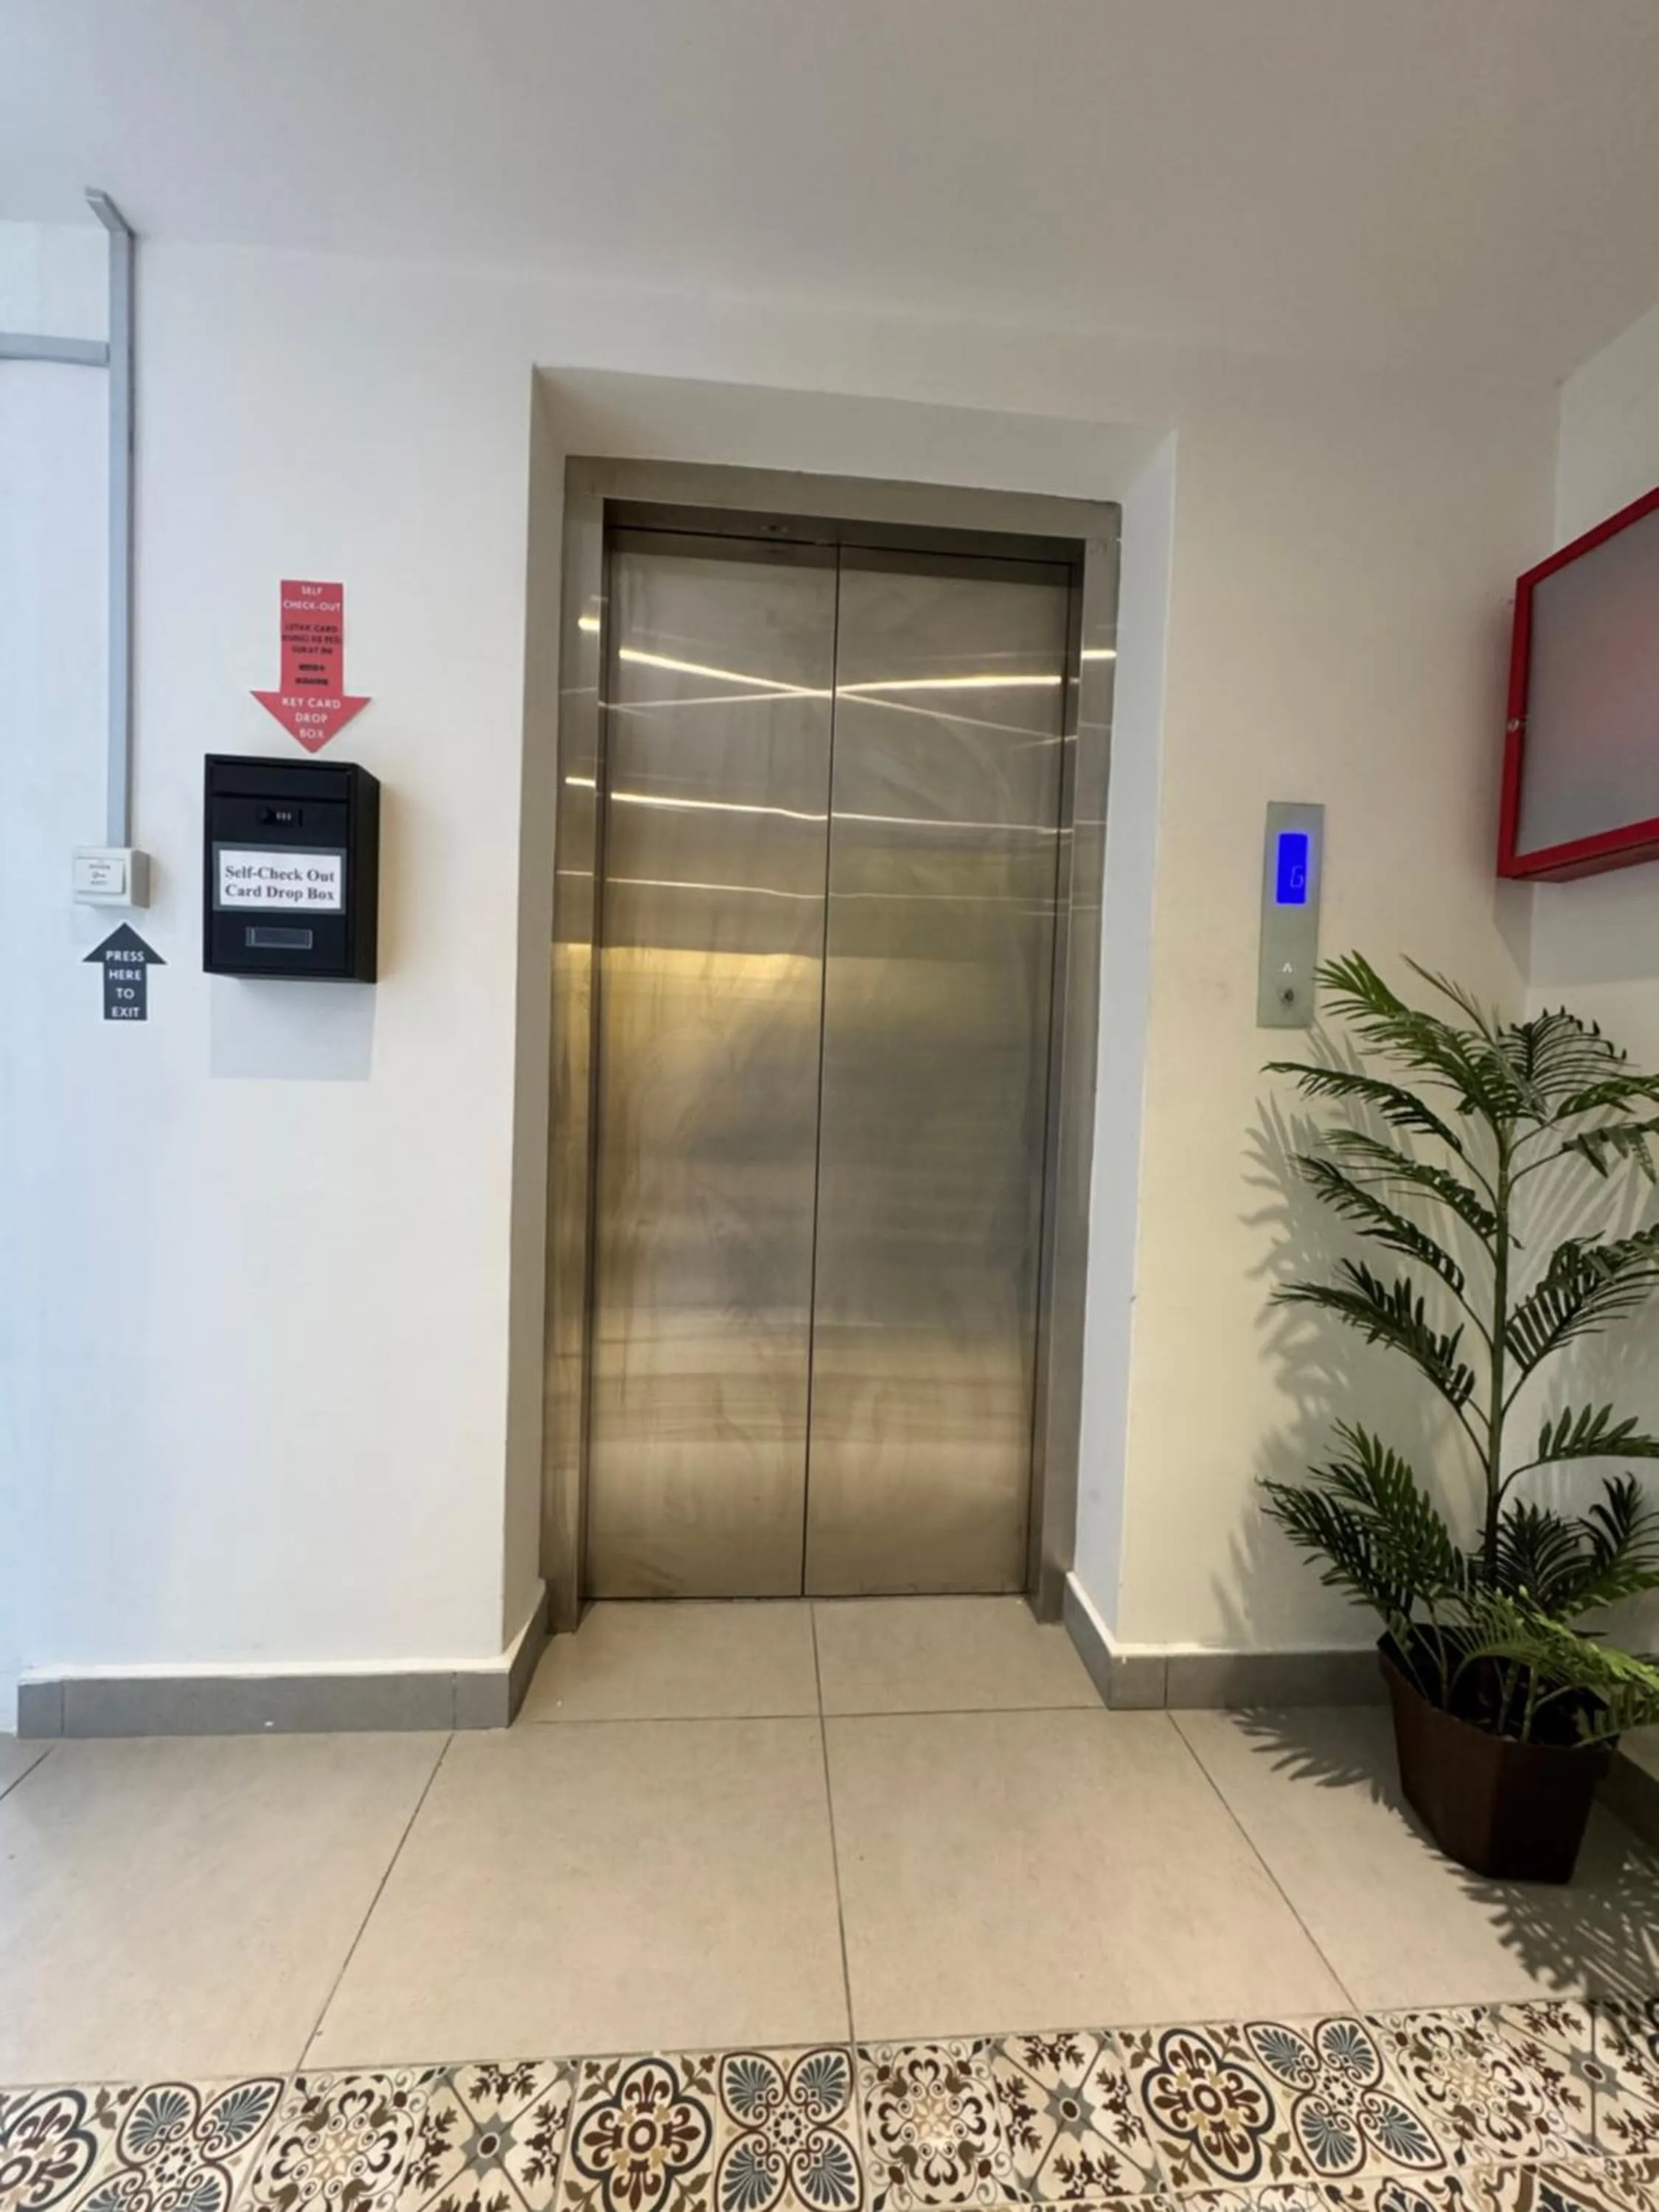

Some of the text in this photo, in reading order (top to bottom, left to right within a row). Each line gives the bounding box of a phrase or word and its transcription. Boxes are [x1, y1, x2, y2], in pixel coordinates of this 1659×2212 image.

[301, 585, 323, 595] SELF
[283, 600, 341, 611] CHECK-OUT
[282, 698, 341, 709] KEY CARD
[295, 712, 328, 724] DROP
[299, 728, 324, 739] BOX
[225, 865, 335, 883] Self-Check Out
[225, 884, 335, 902] Card Drop Box
[105, 950, 145, 962] PRESS
[109, 969, 142, 981] HERE
[116, 988, 135, 999] TO
[111, 1007, 140, 1018] EXIT
